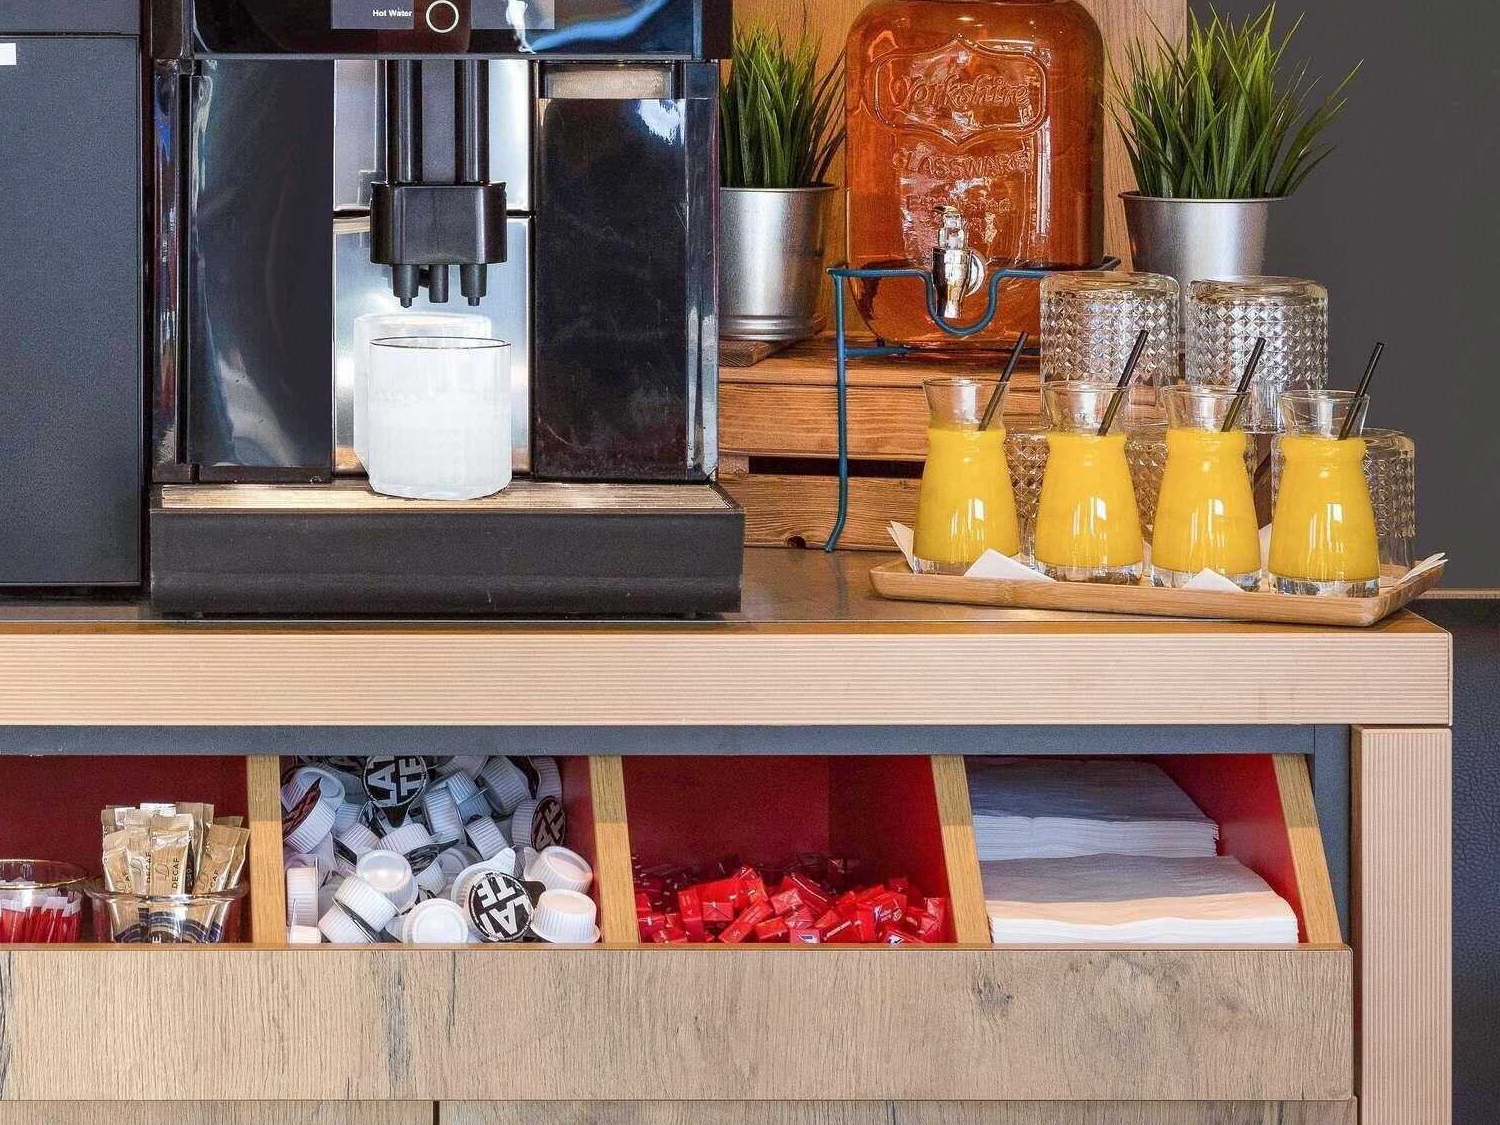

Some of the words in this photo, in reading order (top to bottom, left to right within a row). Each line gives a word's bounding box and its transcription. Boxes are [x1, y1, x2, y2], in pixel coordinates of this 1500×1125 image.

[372, 9, 387, 17] Hot
[388, 8, 412, 17] Water
[172, 857, 180, 889] DECAF
